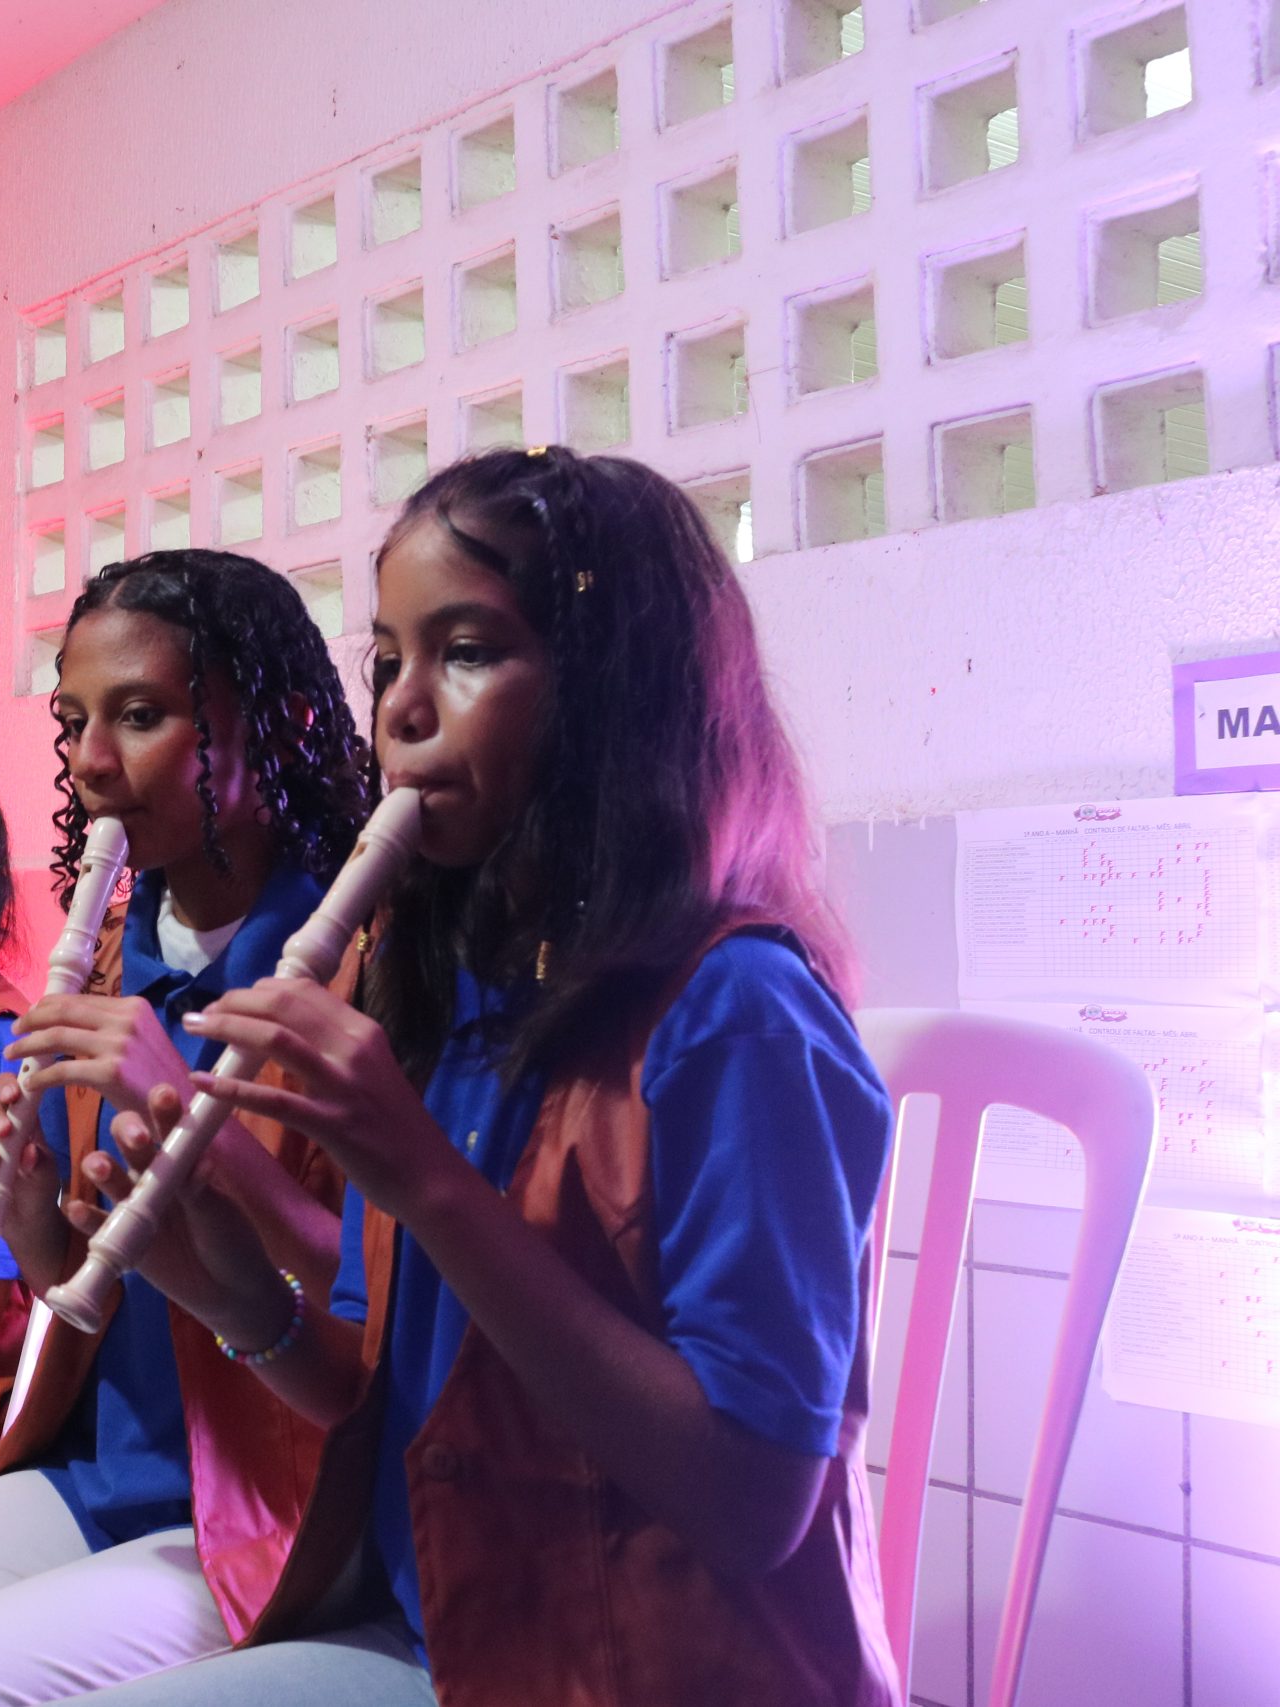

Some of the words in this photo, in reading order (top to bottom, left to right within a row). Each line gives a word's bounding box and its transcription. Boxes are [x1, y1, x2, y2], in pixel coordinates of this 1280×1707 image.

[1055, 827, 1079, 836] MANHÃ
[1084, 826, 1118, 835] CONTROLE
[1127, 824, 1151, 832] FALTAS
[1174, 822, 1192, 830] ABRIL
[1088, 1027, 1122, 1036] CONTROLE
[1132, 1029, 1156, 1037] FALTAS
[1180, 1030, 1198, 1038] ABRIL
[1211, 1236, 1238, 1245] MANHÃ
